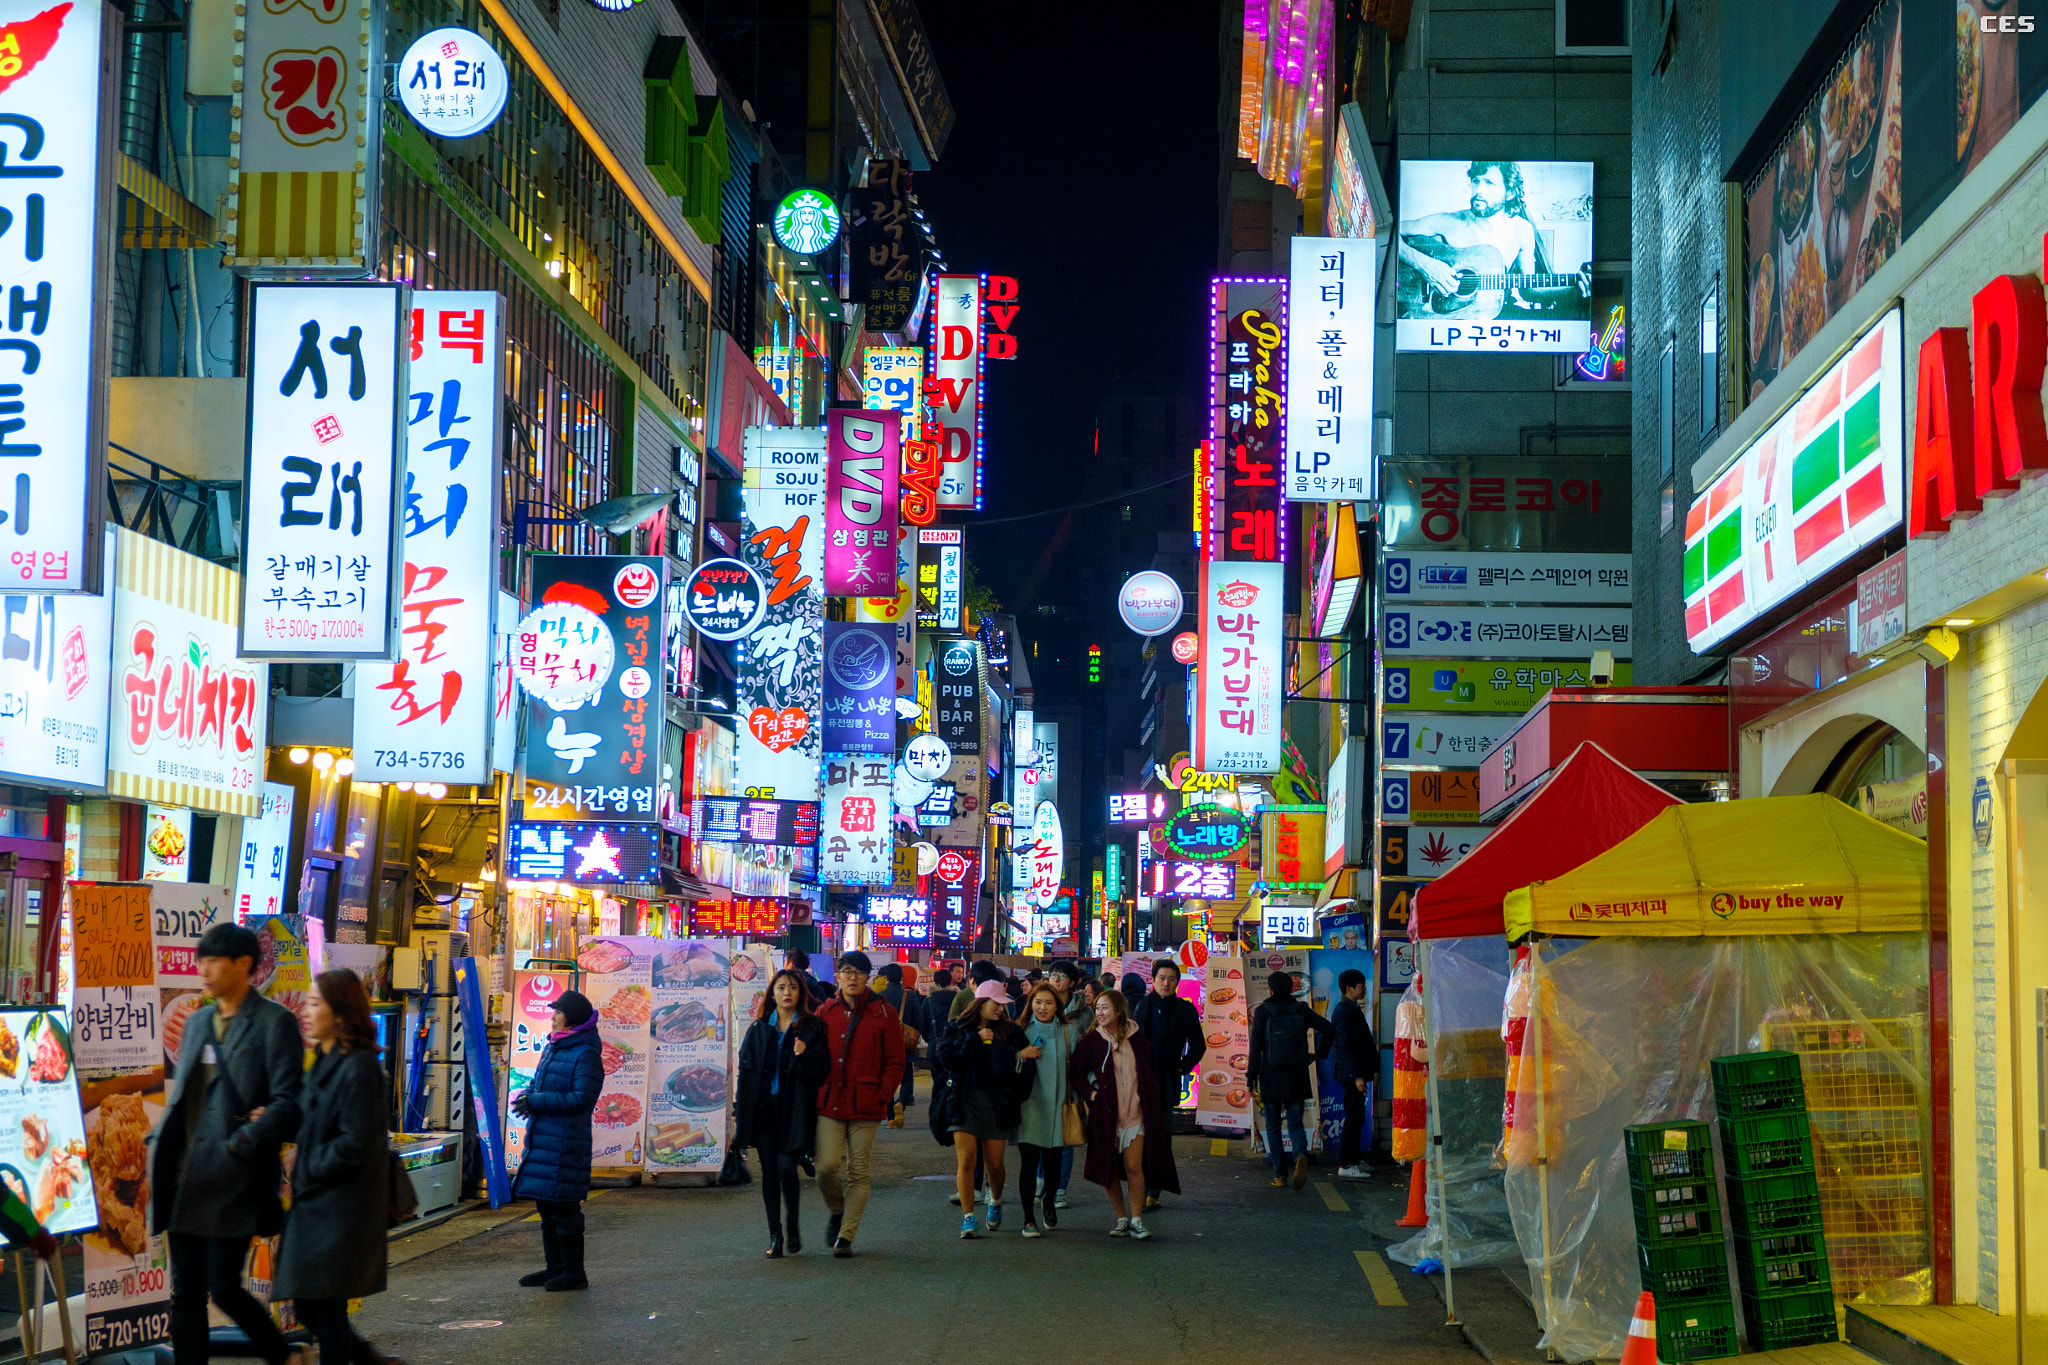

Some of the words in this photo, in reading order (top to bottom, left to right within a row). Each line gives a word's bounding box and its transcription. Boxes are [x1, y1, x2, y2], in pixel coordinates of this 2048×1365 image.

[267, 0, 338, 135] 킨
[409, 59, 485, 91] 서래
[868, 158, 909, 282] 다락방
[986, 275, 1020, 358] DVD
[1430, 327, 1461, 346] LP
[1468, 325, 1561, 347] 구멍가게
[869, 355, 918, 371] 엠플러스
[1241, 310, 1282, 429] Praha
[940, 325, 973, 463] DVD
[1228, 341, 1253, 426] 프라하
[679, 447, 699, 487] ROOM
[772, 451, 819, 465] ROOM
[840, 414, 884, 526] DVD
[1295, 451, 1330, 473] LP
[775, 472, 818, 485] SOJU
[942, 478, 966, 494] 5F
[1294, 476, 1363, 493] 음악카페
[678, 489, 697, 525] SOJU
[785, 493, 817, 506] HOF
[1420, 476, 1602, 542] 종로코아
[677, 529, 692, 562] HOF
[832, 529, 890, 547] 상영관
[11, 550, 68, 580] 영업
[266, 554, 371, 582] 갈매기살
[846, 550, 874, 583] 美
[1389, 563, 1408, 588] 9
[1478, 567, 1525, 586] 펠리스
[1530, 567, 1592, 587] 스페인어
[1597, 567, 1629, 587] 학원
[263, 586, 366, 613] 부속고기
[854, 584, 869, 593] 3F
[941, 551, 957, 622] 청춘포차
[1125, 598, 1176, 610] 박가부대
[539, 616, 600, 649] 막회
[701, 616, 739, 629] 24시영업
[1388, 617, 1408, 643] 8
[1477, 623, 1629, 642] (주)코아토탈시스템
[520, 632, 537, 676] 영덕
[538, 652, 597, 689] 물회
[1217, 613, 1260, 736] 박가부대
[125, 627, 257, 753] 굽네치킨
[942, 685, 973, 697] PUB
[1388, 672, 1407, 698] 8
[941, 710, 973, 722] BAR
[864, 730, 889, 739] Pizza
[951, 726, 965, 735] 3F
[1388, 728, 1406, 752] 7
[1448, 736, 1495, 752] 한림출
[374, 749, 465, 769] 734-5736
[908, 749, 947, 769] 막창
[1217, 759, 1268, 769] 723-2112
[828, 761, 892, 788] 마포
[1181, 767, 1235, 792] 24시
[532, 785, 653, 812] 24시간영업
[1386, 783, 1405, 809] 6
[1975, 798, 1990, 825] ADT
[1177, 824, 1240, 846] 노래방
[1277, 812, 1302, 883] 노래방
[827, 835, 888, 863] 곱창
[1385, 838, 1404, 864] 5
[842, 870, 887, 880] 732-1197
[1033, 838, 1059, 897] 노래방
[74, 889, 148, 934] 갈매기살
[696, 900, 779, 931] 국내산
[1387, 890, 1409, 924] 4
[1594, 899, 1669, 919] 롯데제과
[1739, 893, 1771, 915] buy
[1774, 892, 1805, 911] the
[1807, 893, 1844, 912] way
[1266, 916, 1310, 935] 프라하
[76, 1002, 155, 1042] 양념갈비
[88, 1313, 170, 1351] 02-720-1192
